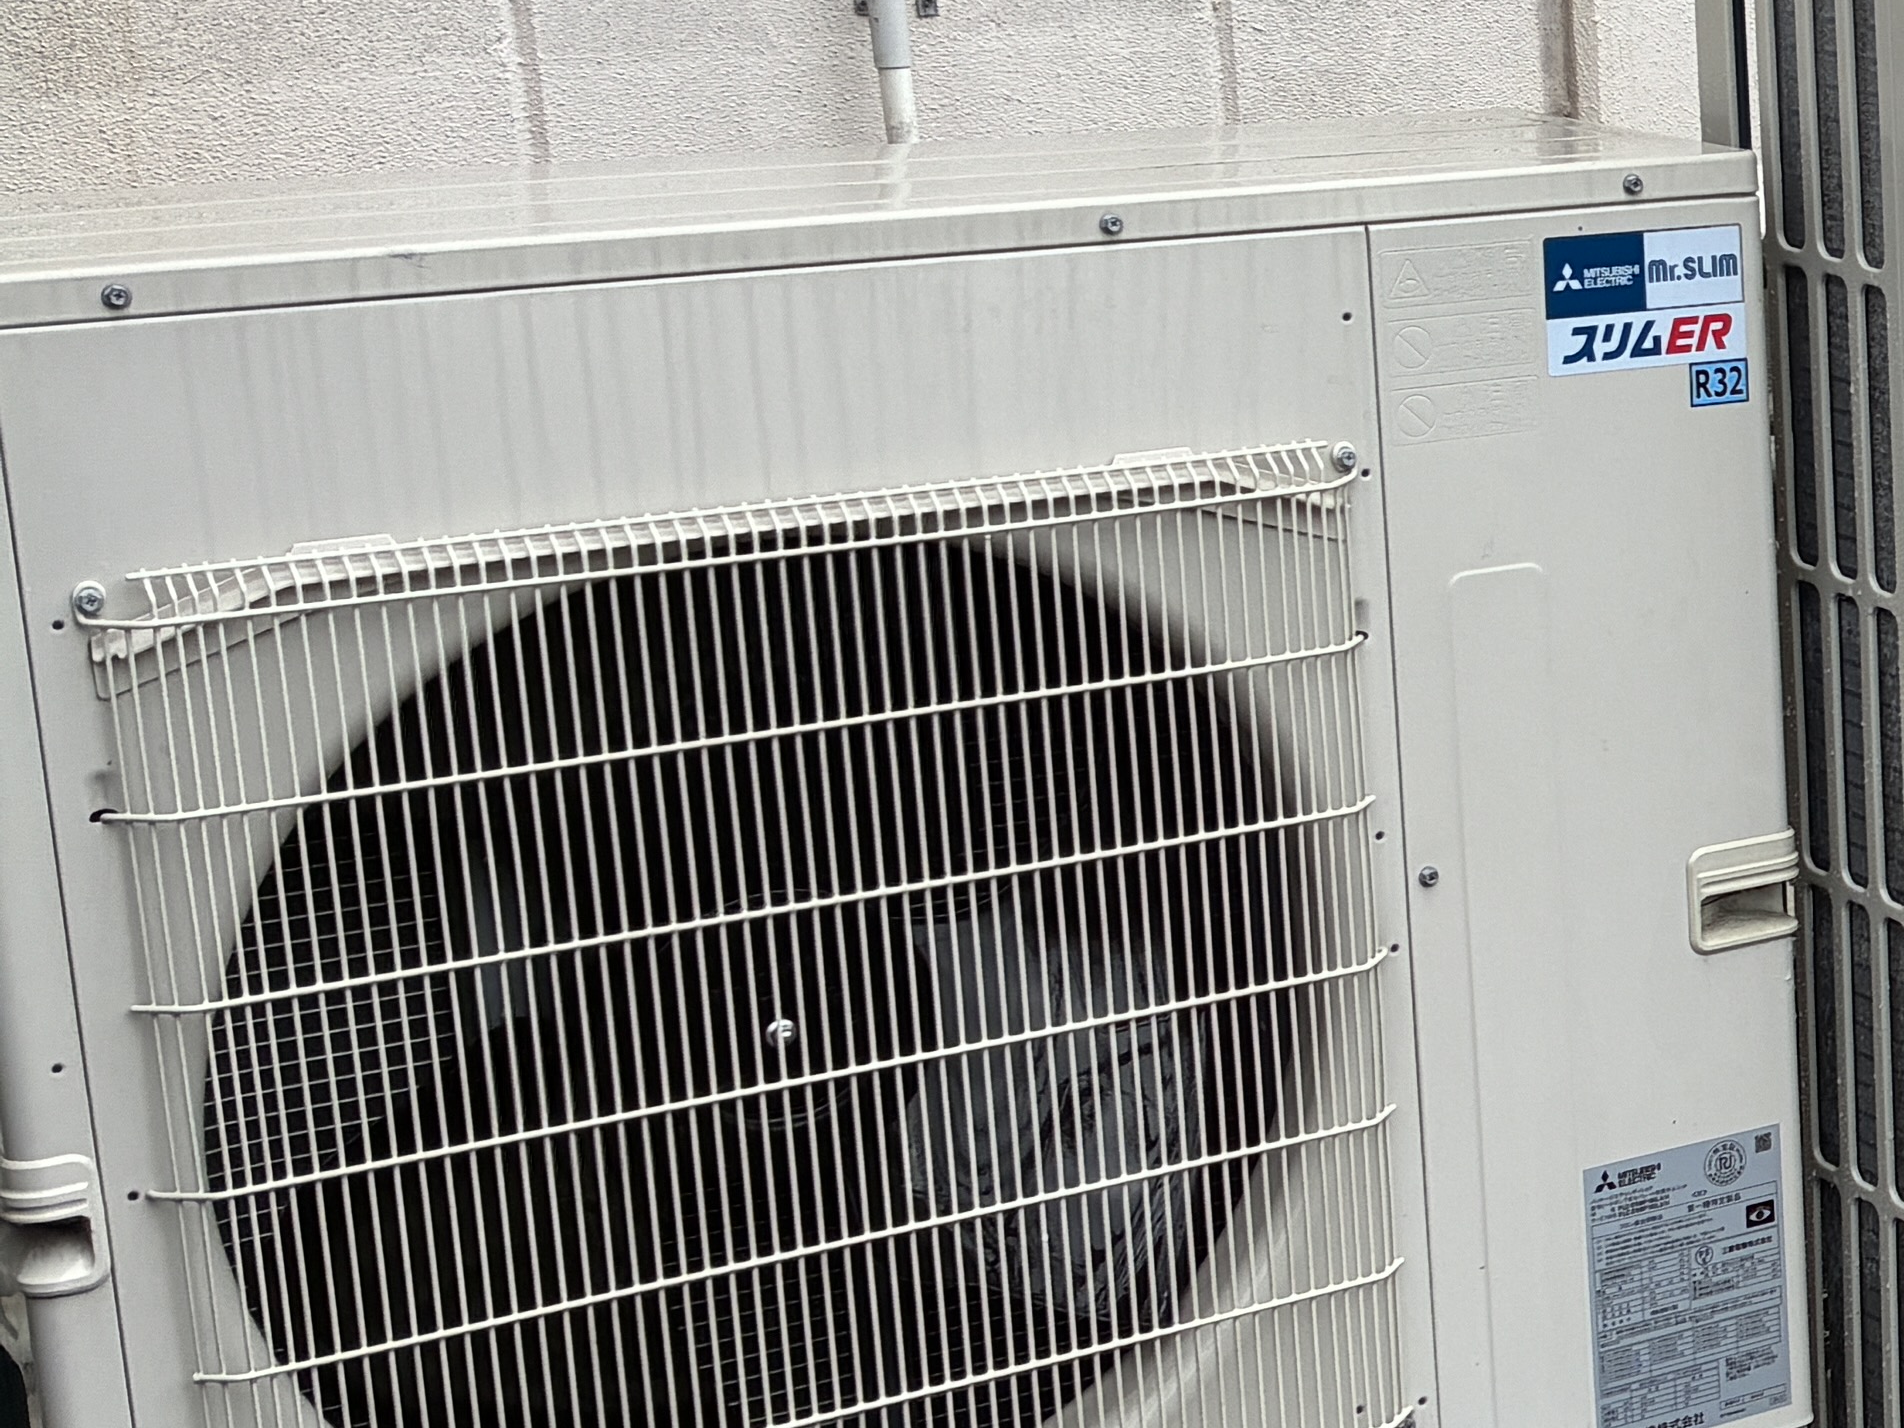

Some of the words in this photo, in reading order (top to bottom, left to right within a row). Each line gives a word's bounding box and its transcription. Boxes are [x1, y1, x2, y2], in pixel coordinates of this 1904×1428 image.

[1583, 264, 1640, 279] MITSUBISHI
[1583, 276, 1634, 290] ELECTRIC
[1647, 253, 1739, 284] Mr.SLIM
[1561, 311, 1734, 366] スリムER
[1694, 368, 1745, 399] R32
